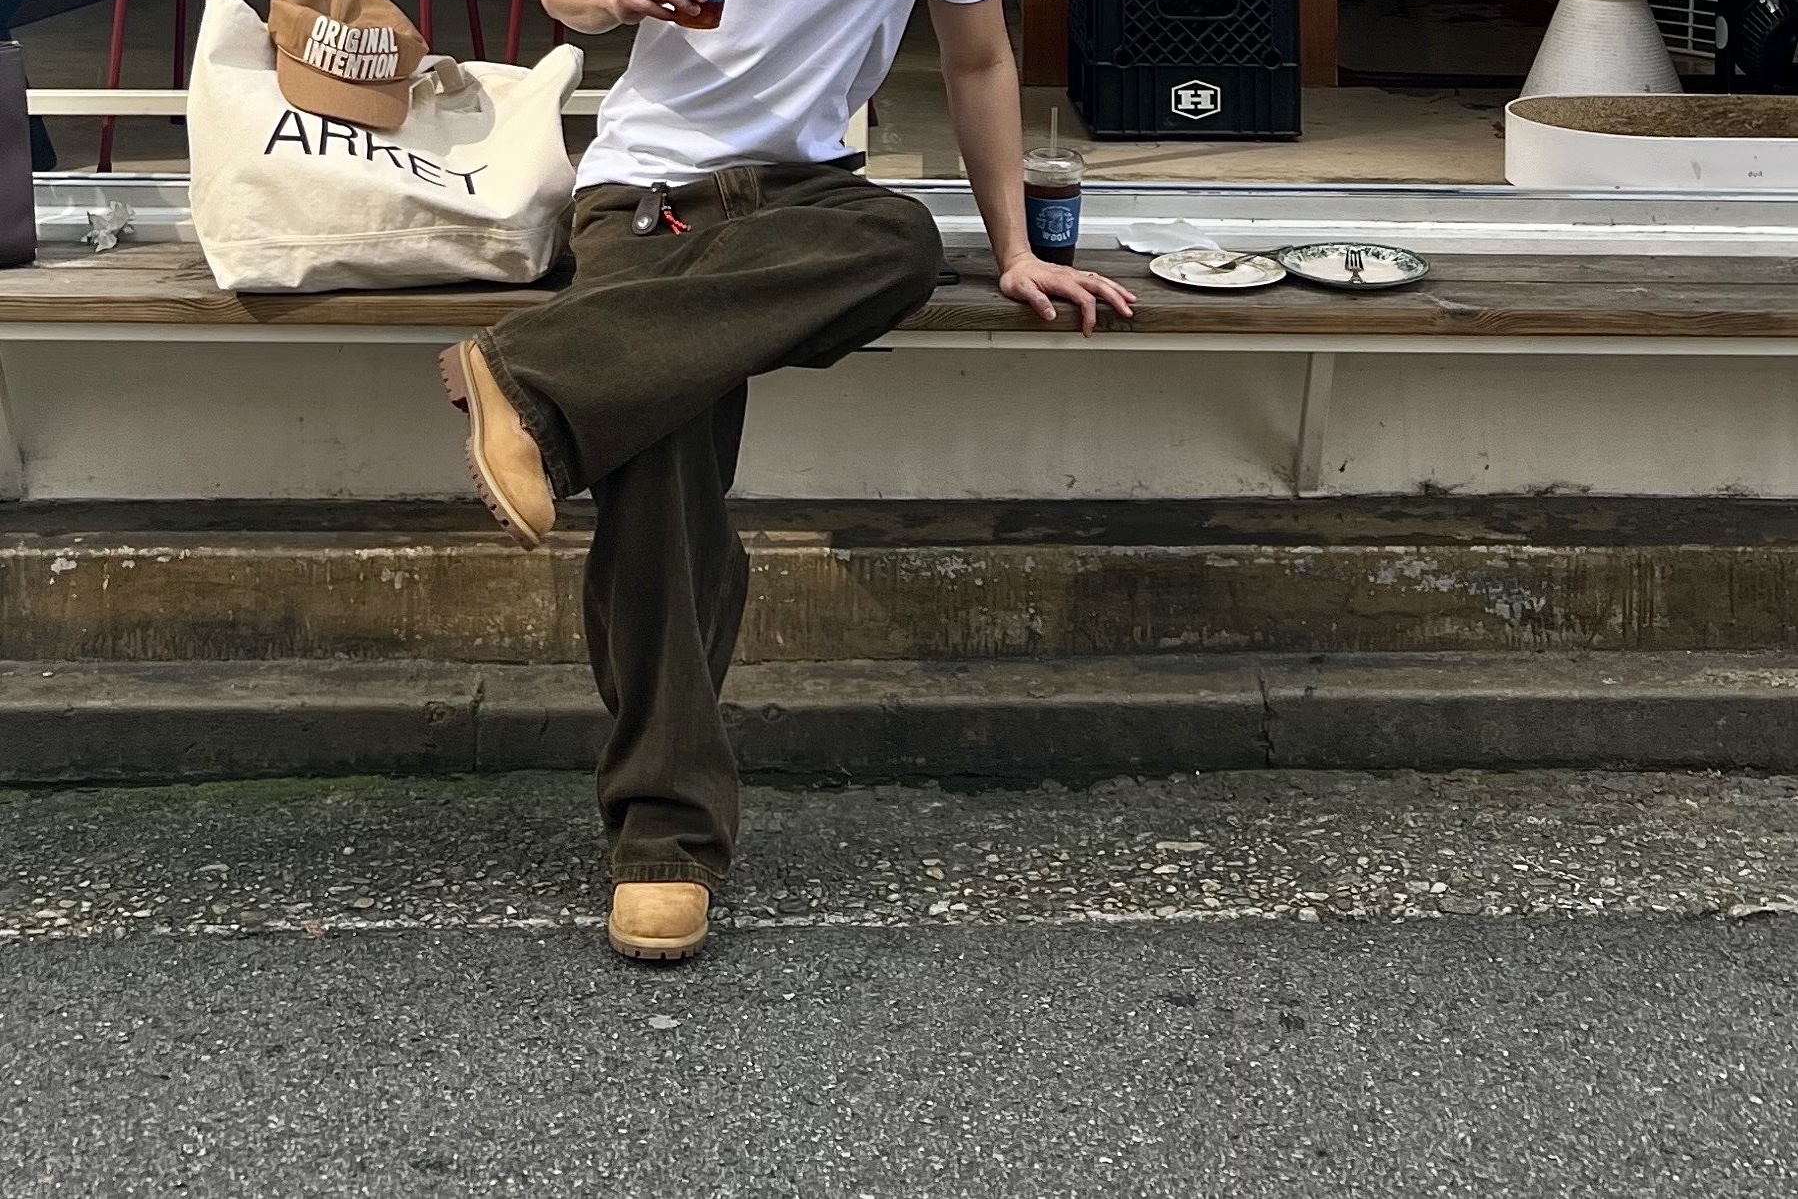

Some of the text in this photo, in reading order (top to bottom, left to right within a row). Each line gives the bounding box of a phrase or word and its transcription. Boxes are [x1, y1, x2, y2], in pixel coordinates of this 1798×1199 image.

[311, 15, 398, 53] ORIGINAL
[303, 37, 399, 80] INTENTION
[264, 109, 488, 194] ARKEY
